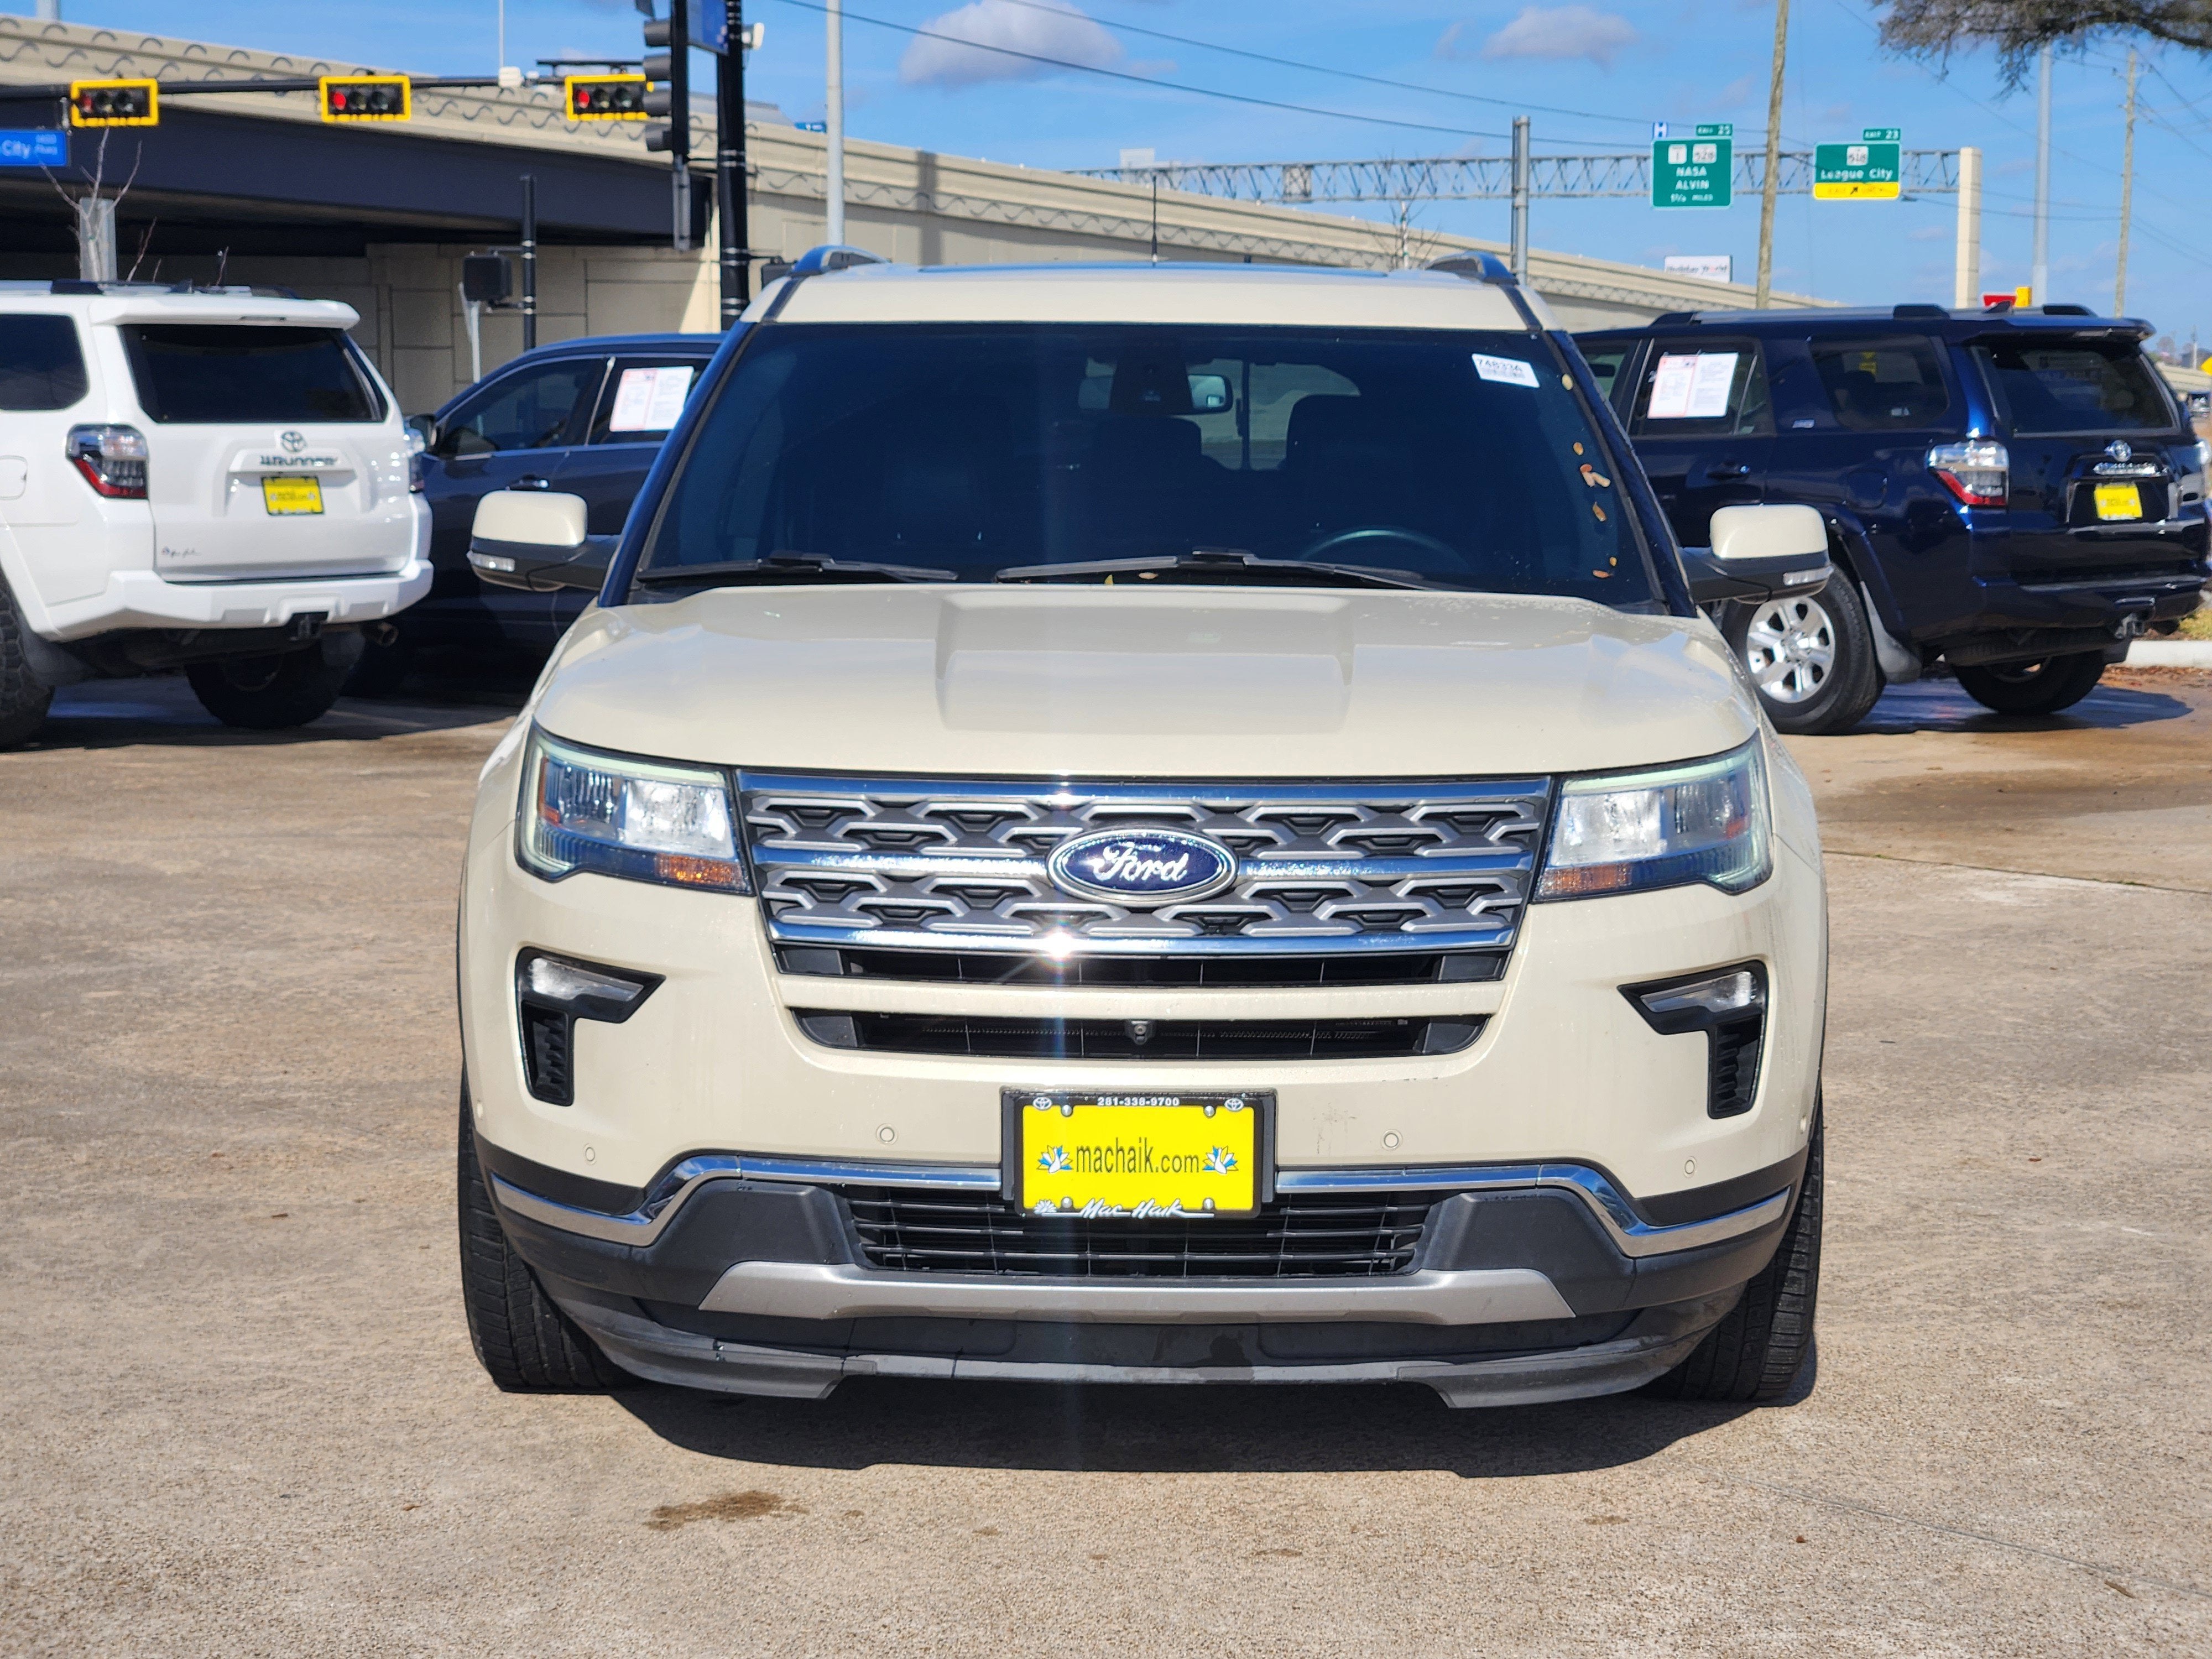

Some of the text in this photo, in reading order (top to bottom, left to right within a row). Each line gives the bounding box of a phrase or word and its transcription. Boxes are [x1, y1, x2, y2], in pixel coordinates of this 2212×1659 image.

[1885, 130, 1898, 139] 23
[1676, 166, 1707, 176] NASA
[1821, 167, 1893, 181] League City
[1675, 180, 1709, 190] ALVIN
[1091, 841, 1189, 881] Ford
[1097, 1097, 1180, 1106] 281-338-9700
[1076, 1136, 1199, 1173] machaik.com
[1079, 1198, 1185, 1219] Mac Haik
